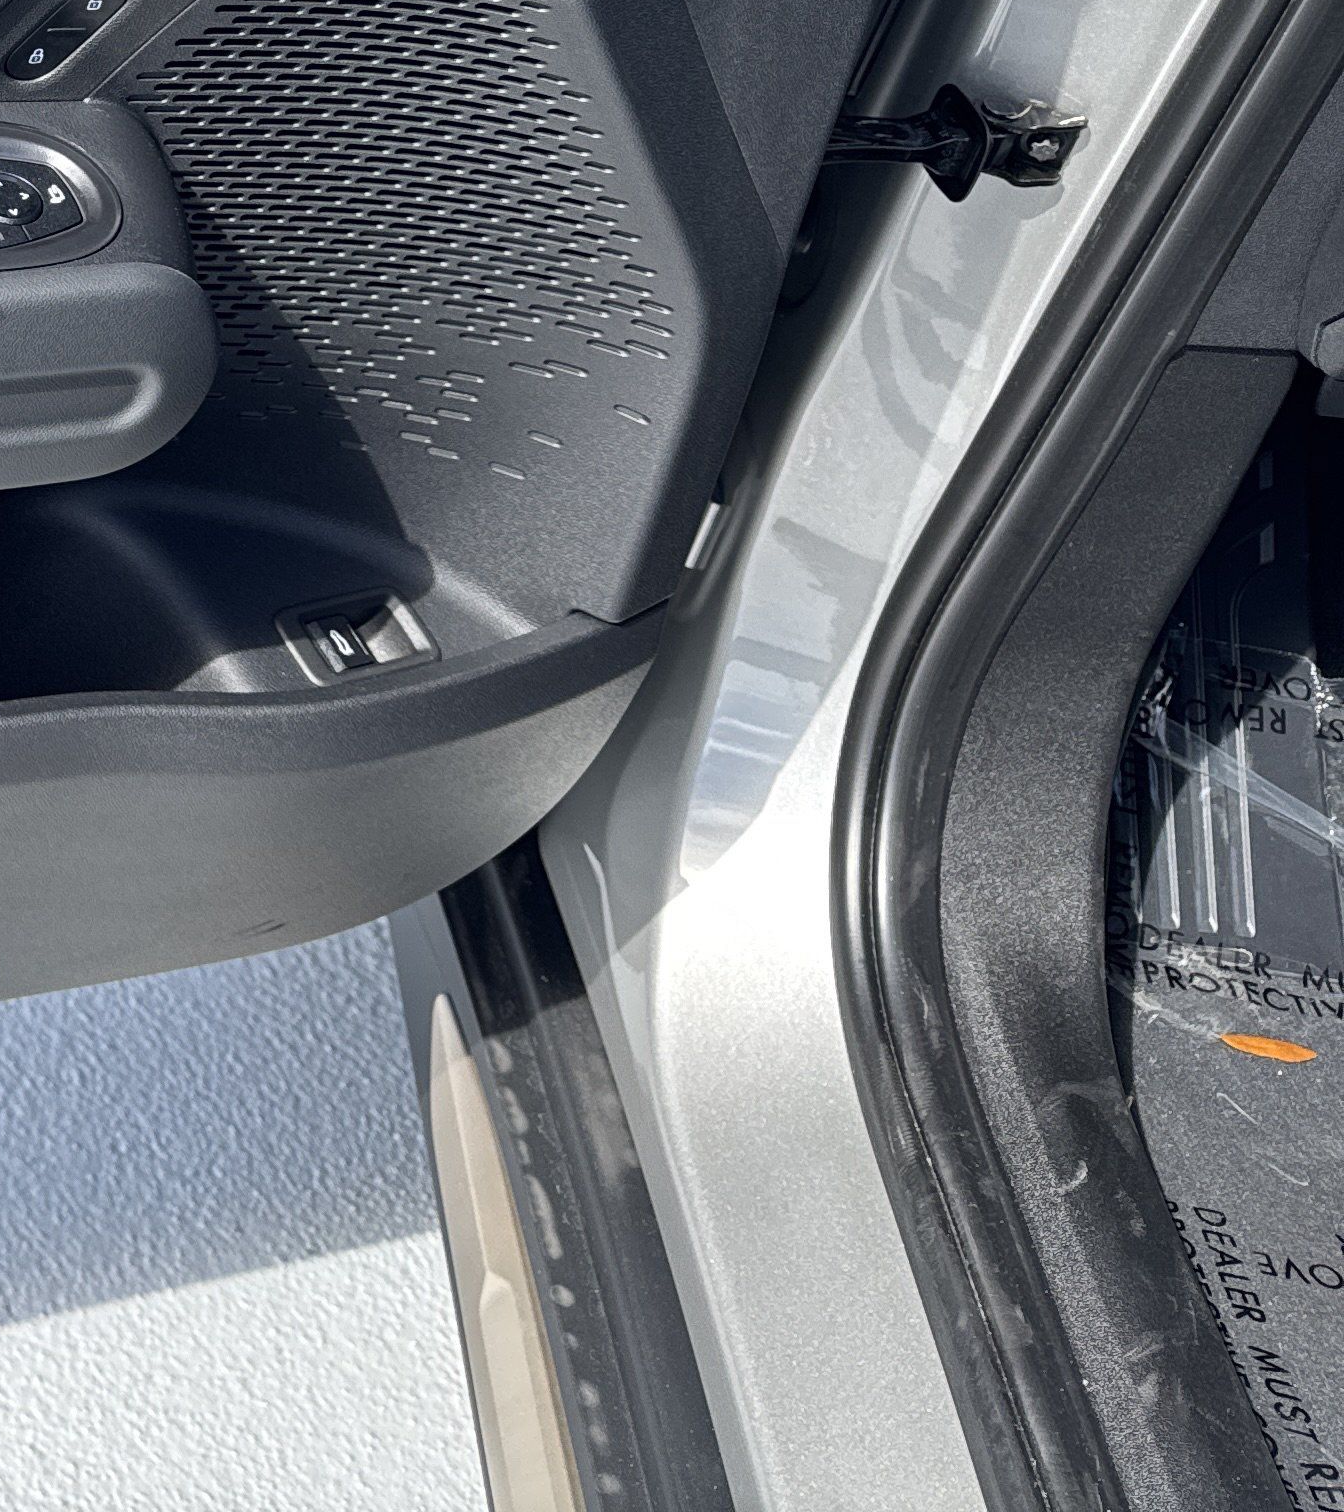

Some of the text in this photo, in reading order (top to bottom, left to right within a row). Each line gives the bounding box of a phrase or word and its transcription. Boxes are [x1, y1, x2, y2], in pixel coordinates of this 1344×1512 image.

[1139, 923, 1273, 980] DEALER
[1193, 1205, 1267, 1324] DEALER
[1249, 1345, 1321, 1444] MUST
